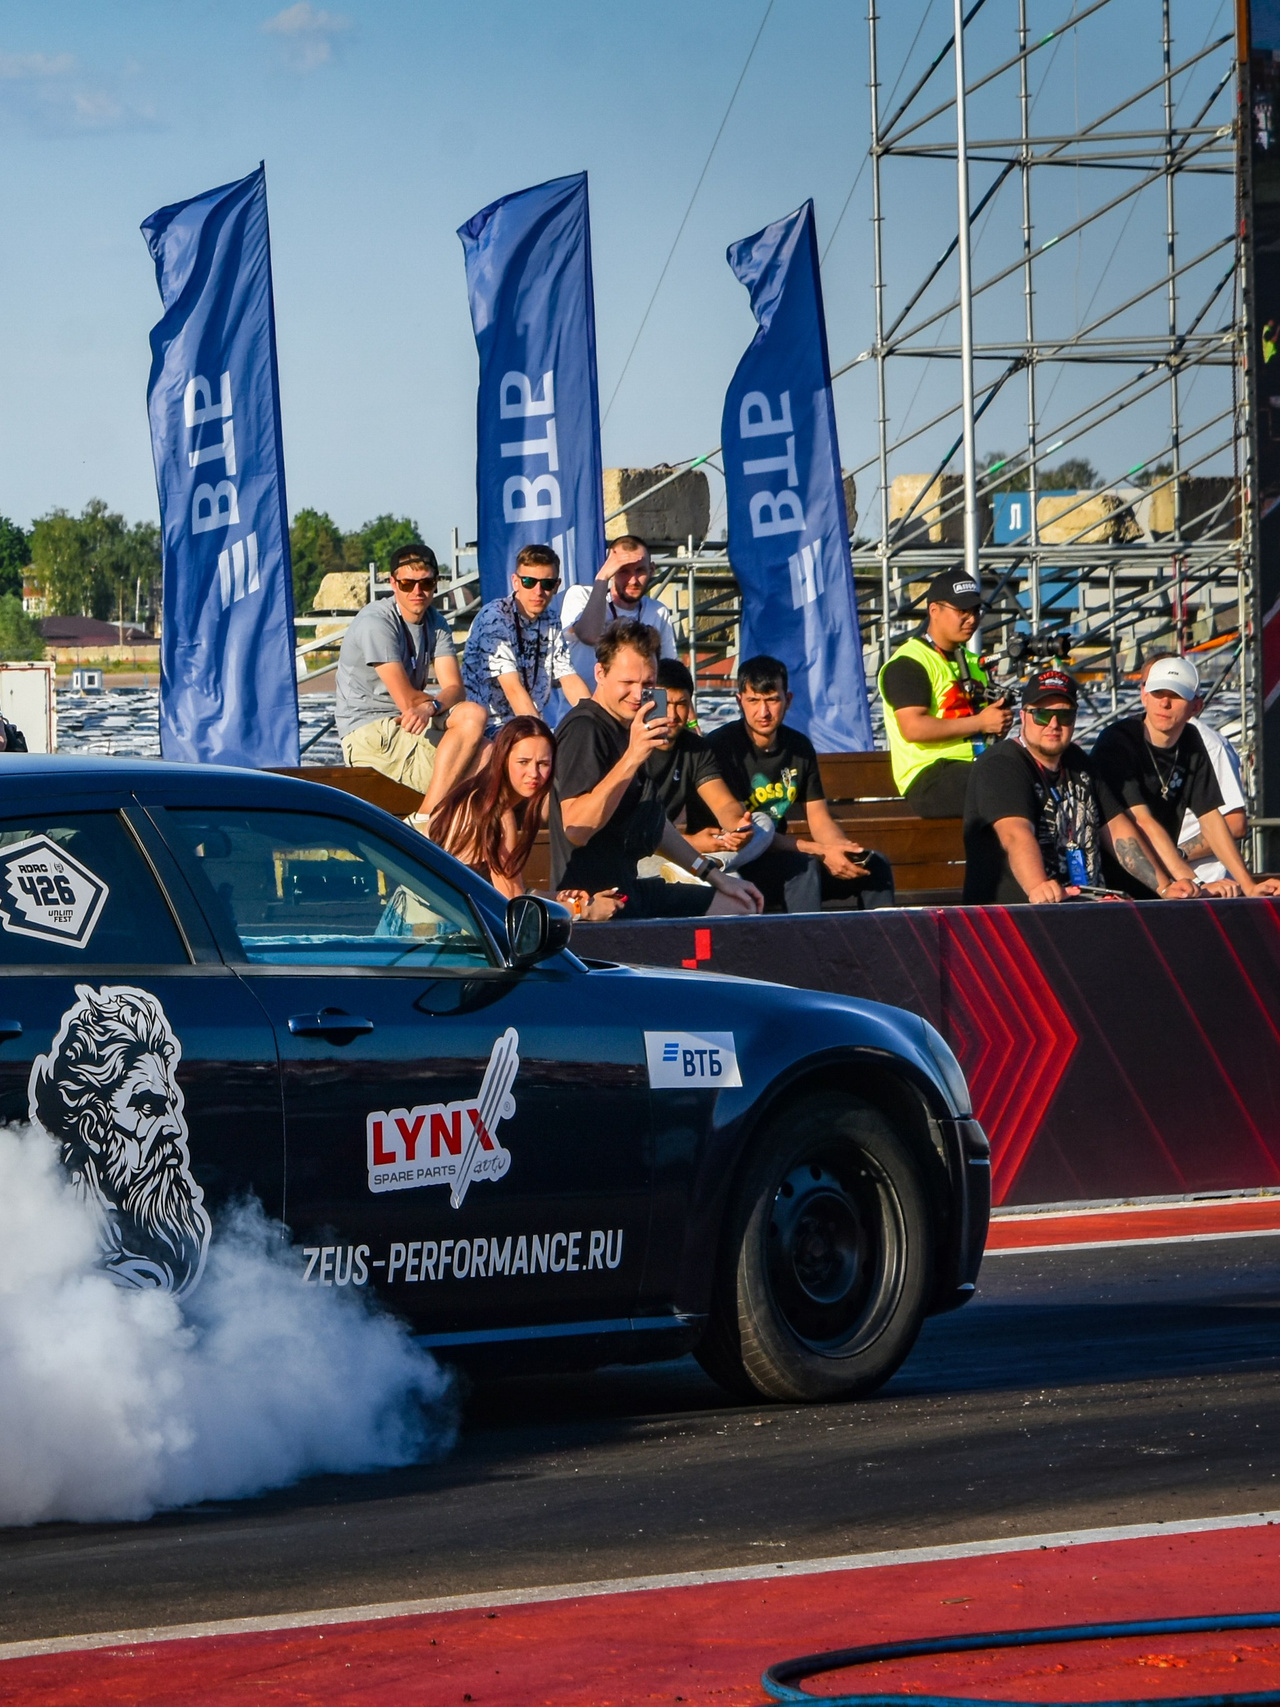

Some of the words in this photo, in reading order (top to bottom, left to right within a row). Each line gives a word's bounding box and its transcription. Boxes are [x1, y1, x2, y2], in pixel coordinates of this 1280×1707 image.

[18, 864, 48, 873] RDRC
[17, 875, 76, 906] 426
[682, 1049, 722, 1077] ВТБ
[373, 1108, 495, 1166] LYNX
[374, 1170, 414, 1185] SPARE
[416, 1165, 456, 1179] PARTS
[301, 1229, 623, 1288] ZEUS-PERFORMANCE.RU
